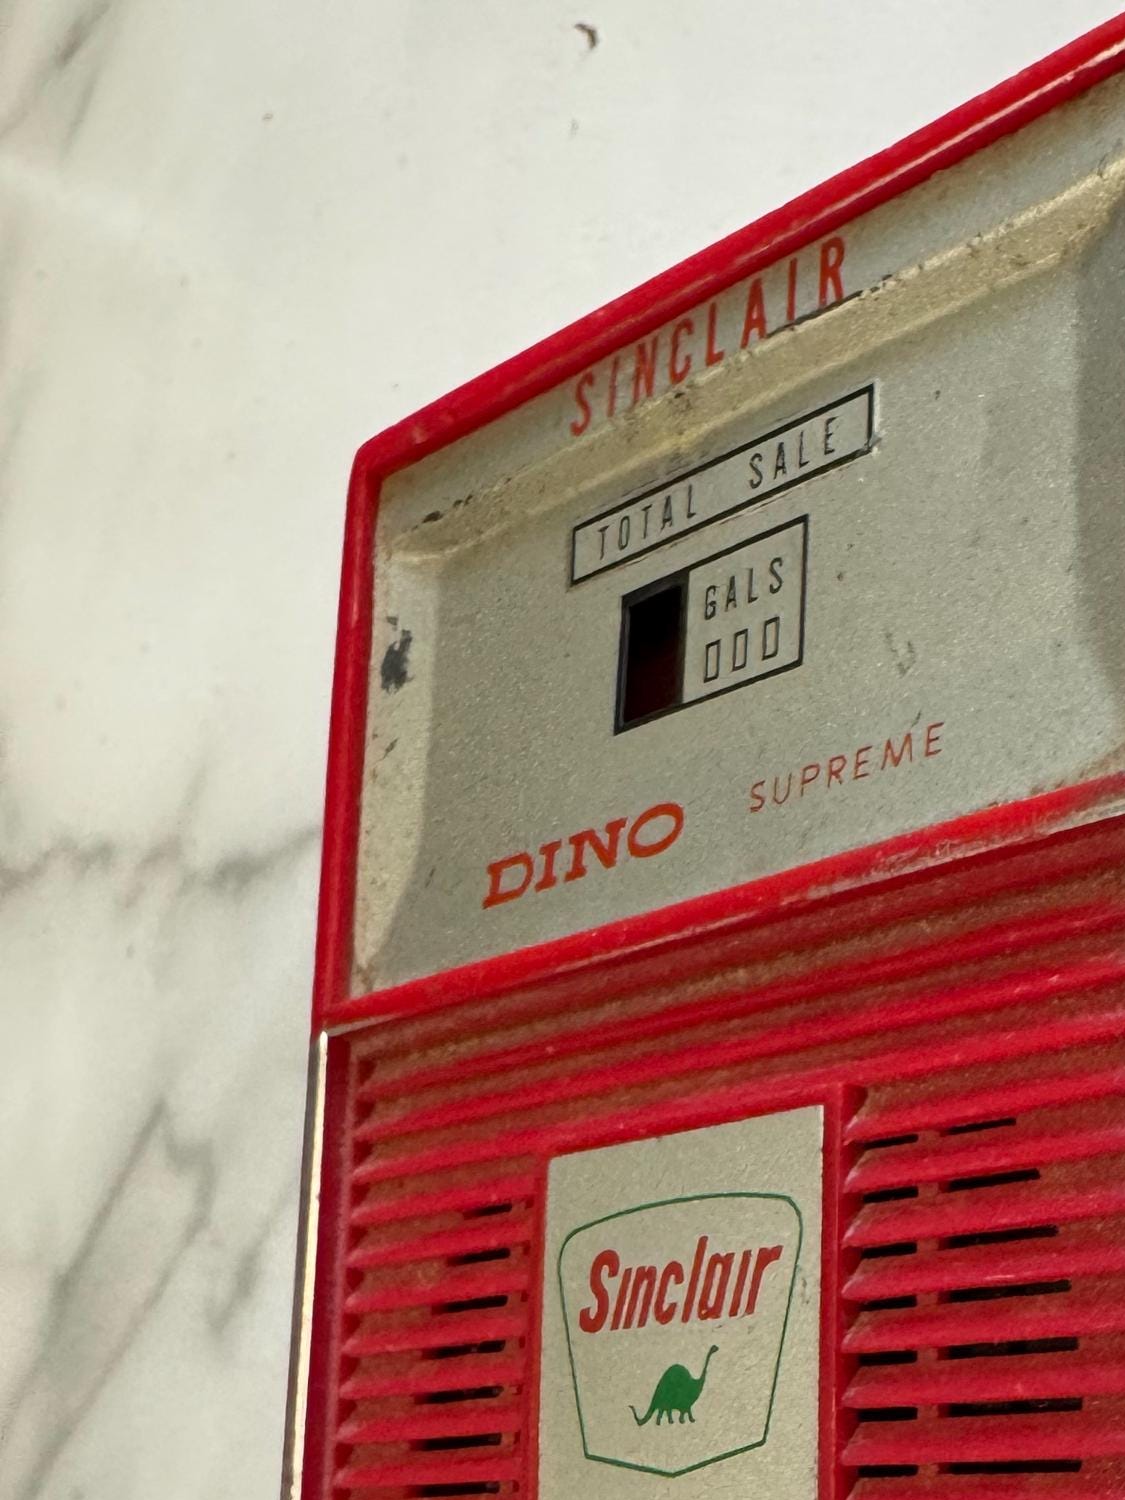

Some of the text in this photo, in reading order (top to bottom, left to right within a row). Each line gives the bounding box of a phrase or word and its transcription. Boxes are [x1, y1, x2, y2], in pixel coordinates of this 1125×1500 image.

[569, 235, 847, 437] SINCLAIR
[597, 416, 840, 561] TOTAL SALE
[704, 557, 785, 621] GALS
[482, 722, 945, 910] DINO SUPREME
[578, 1235, 784, 1334] Sinclair
